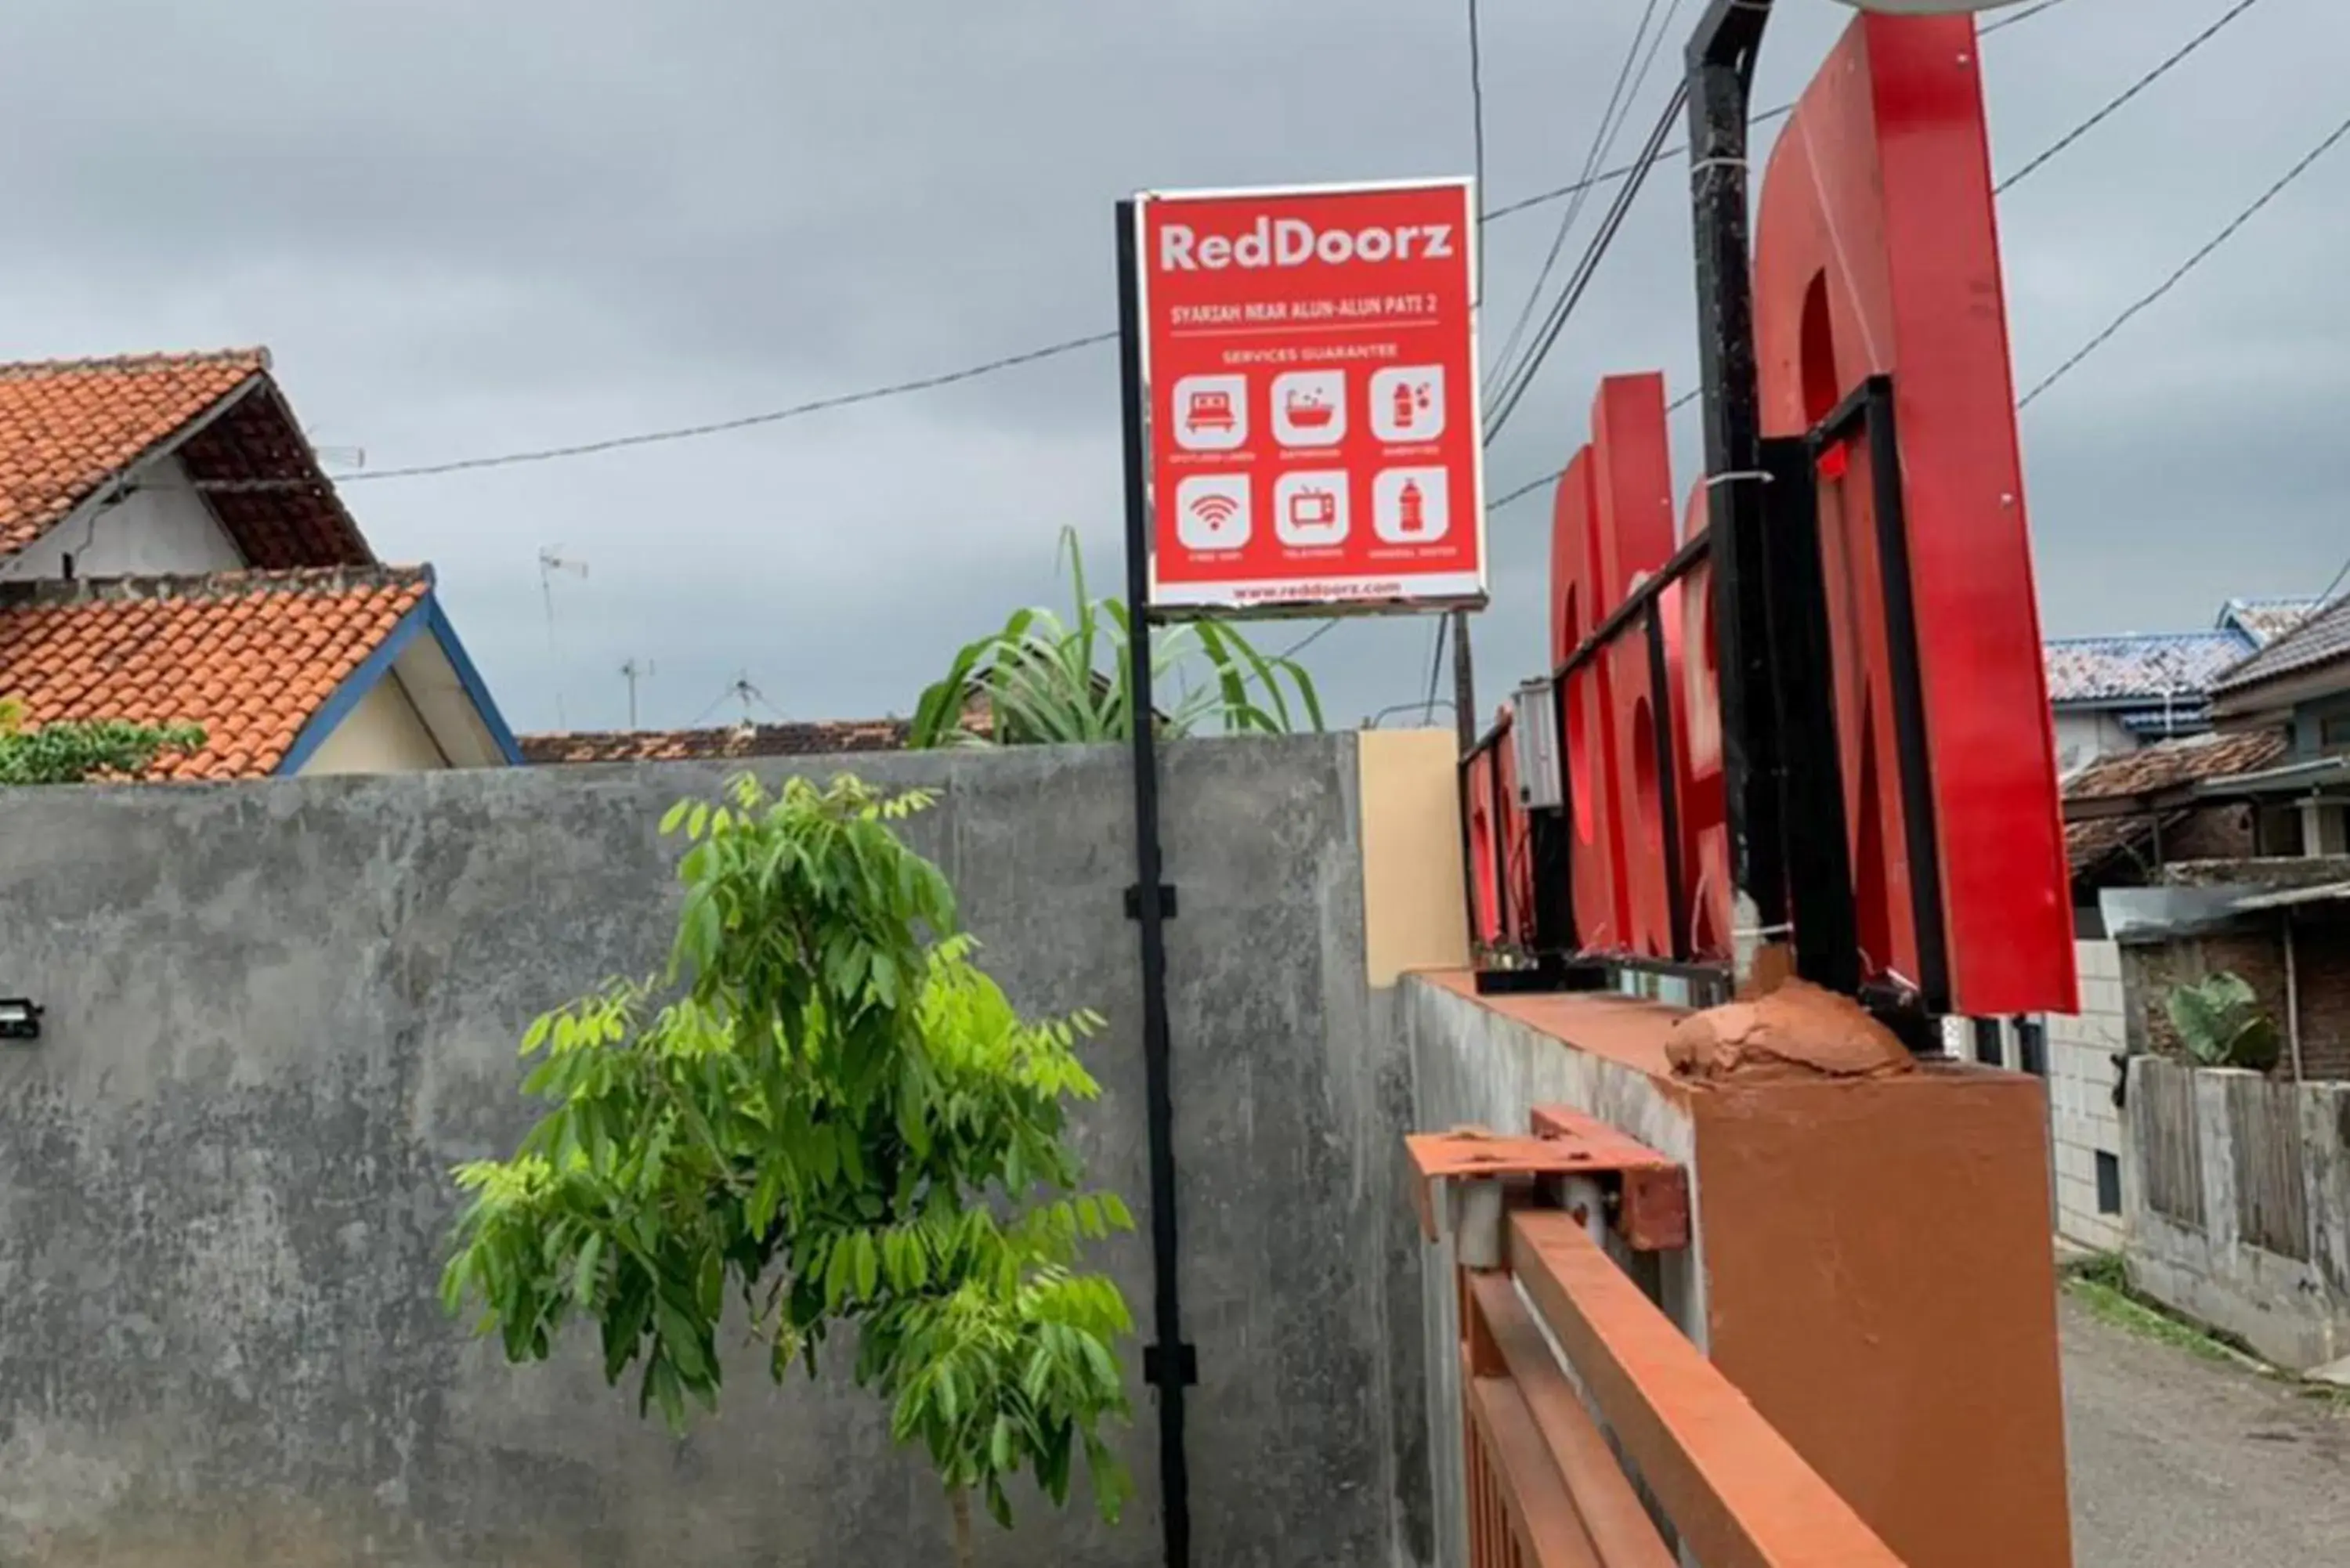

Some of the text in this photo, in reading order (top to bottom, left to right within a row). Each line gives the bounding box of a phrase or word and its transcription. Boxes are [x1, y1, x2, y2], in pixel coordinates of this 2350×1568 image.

[1160, 216, 1453, 271] RedDoorz
[1170, 292, 1438, 325] SYARIAH NEAR ALUN-ALUN PATI 2
[1222, 342, 1398, 364] SERVICES GUARANTEE
[1234, 582, 1401, 599] www.reddoorz.com
